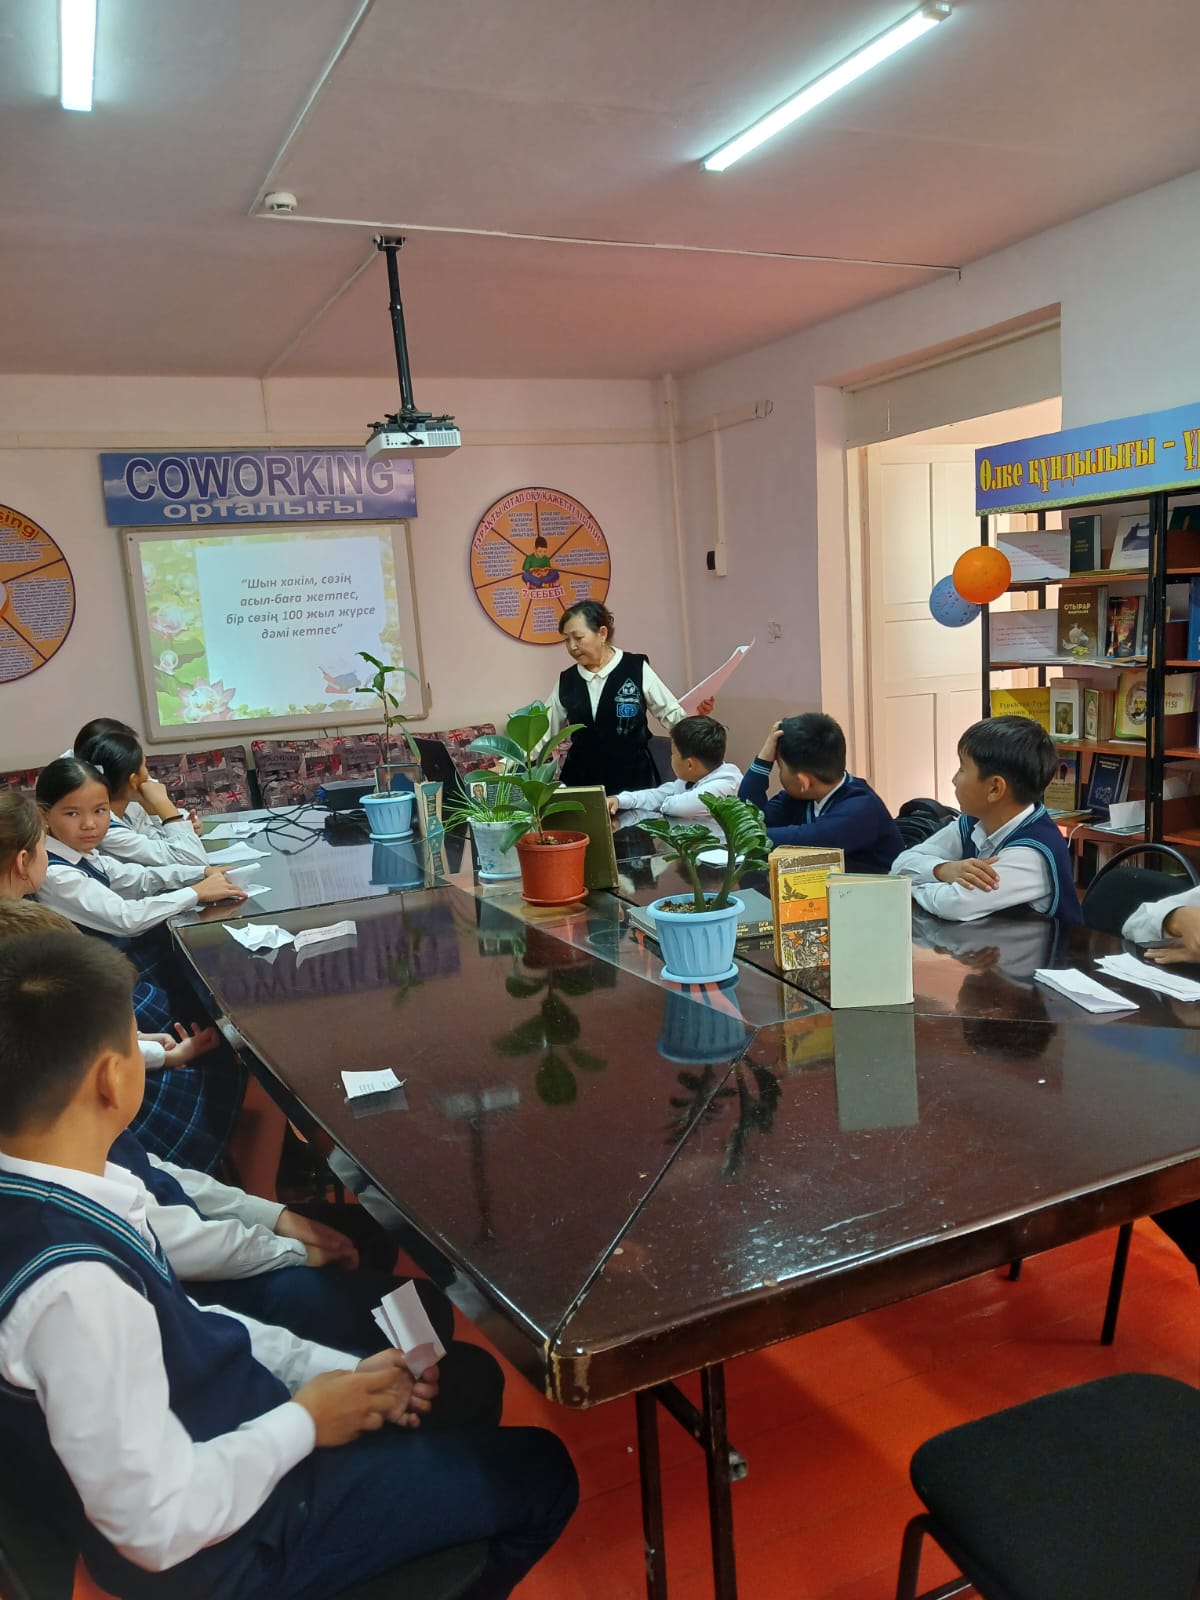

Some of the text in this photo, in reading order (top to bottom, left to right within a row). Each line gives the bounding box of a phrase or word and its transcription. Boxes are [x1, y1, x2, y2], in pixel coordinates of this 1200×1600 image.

[125, 455, 395, 501] COWORKING
[980, 458, 1023, 492] Өлке
[163, 499, 364, 521] орталығы
[226, 613, 245, 626] бір
[282, 610, 303, 621] 100
[306, 609, 335, 619] жыл
